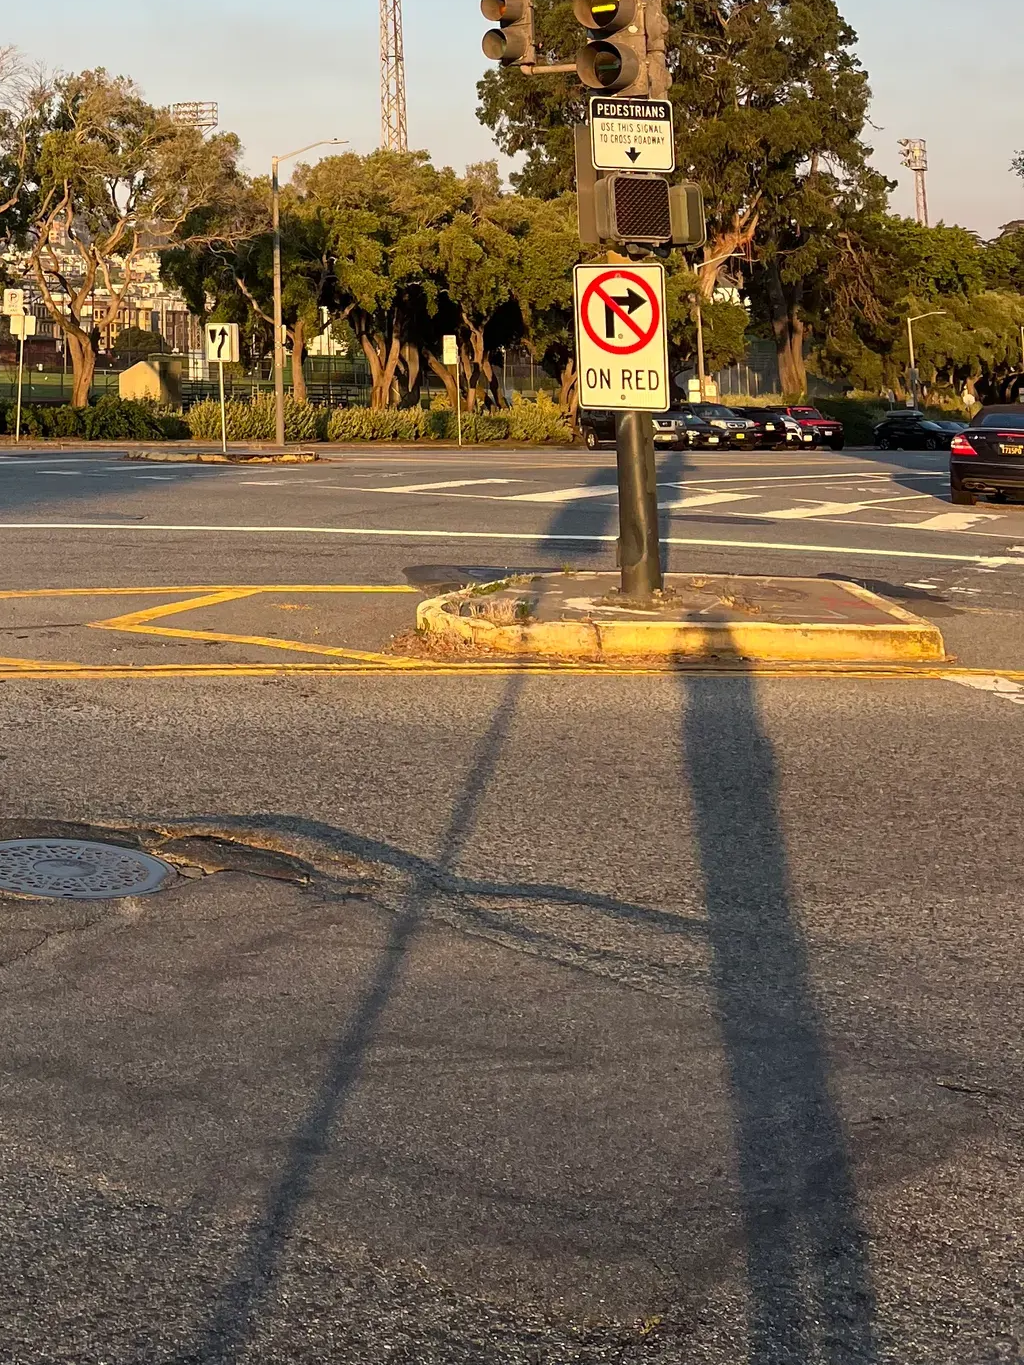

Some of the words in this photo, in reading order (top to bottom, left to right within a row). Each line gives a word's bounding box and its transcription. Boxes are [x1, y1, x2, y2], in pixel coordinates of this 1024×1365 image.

[597, 103, 665, 118] PEDESTRIANS
[600, 122, 614, 132] USE
[618, 123, 634, 132] THIS
[636, 123, 663, 134] SIGNAL
[600, 133, 608, 143] TO
[610, 134, 631, 144] CROSS
[634, 135, 665, 145] ROADWAY
[586, 368, 611, 389] ON
[621, 369, 659, 391] RED
